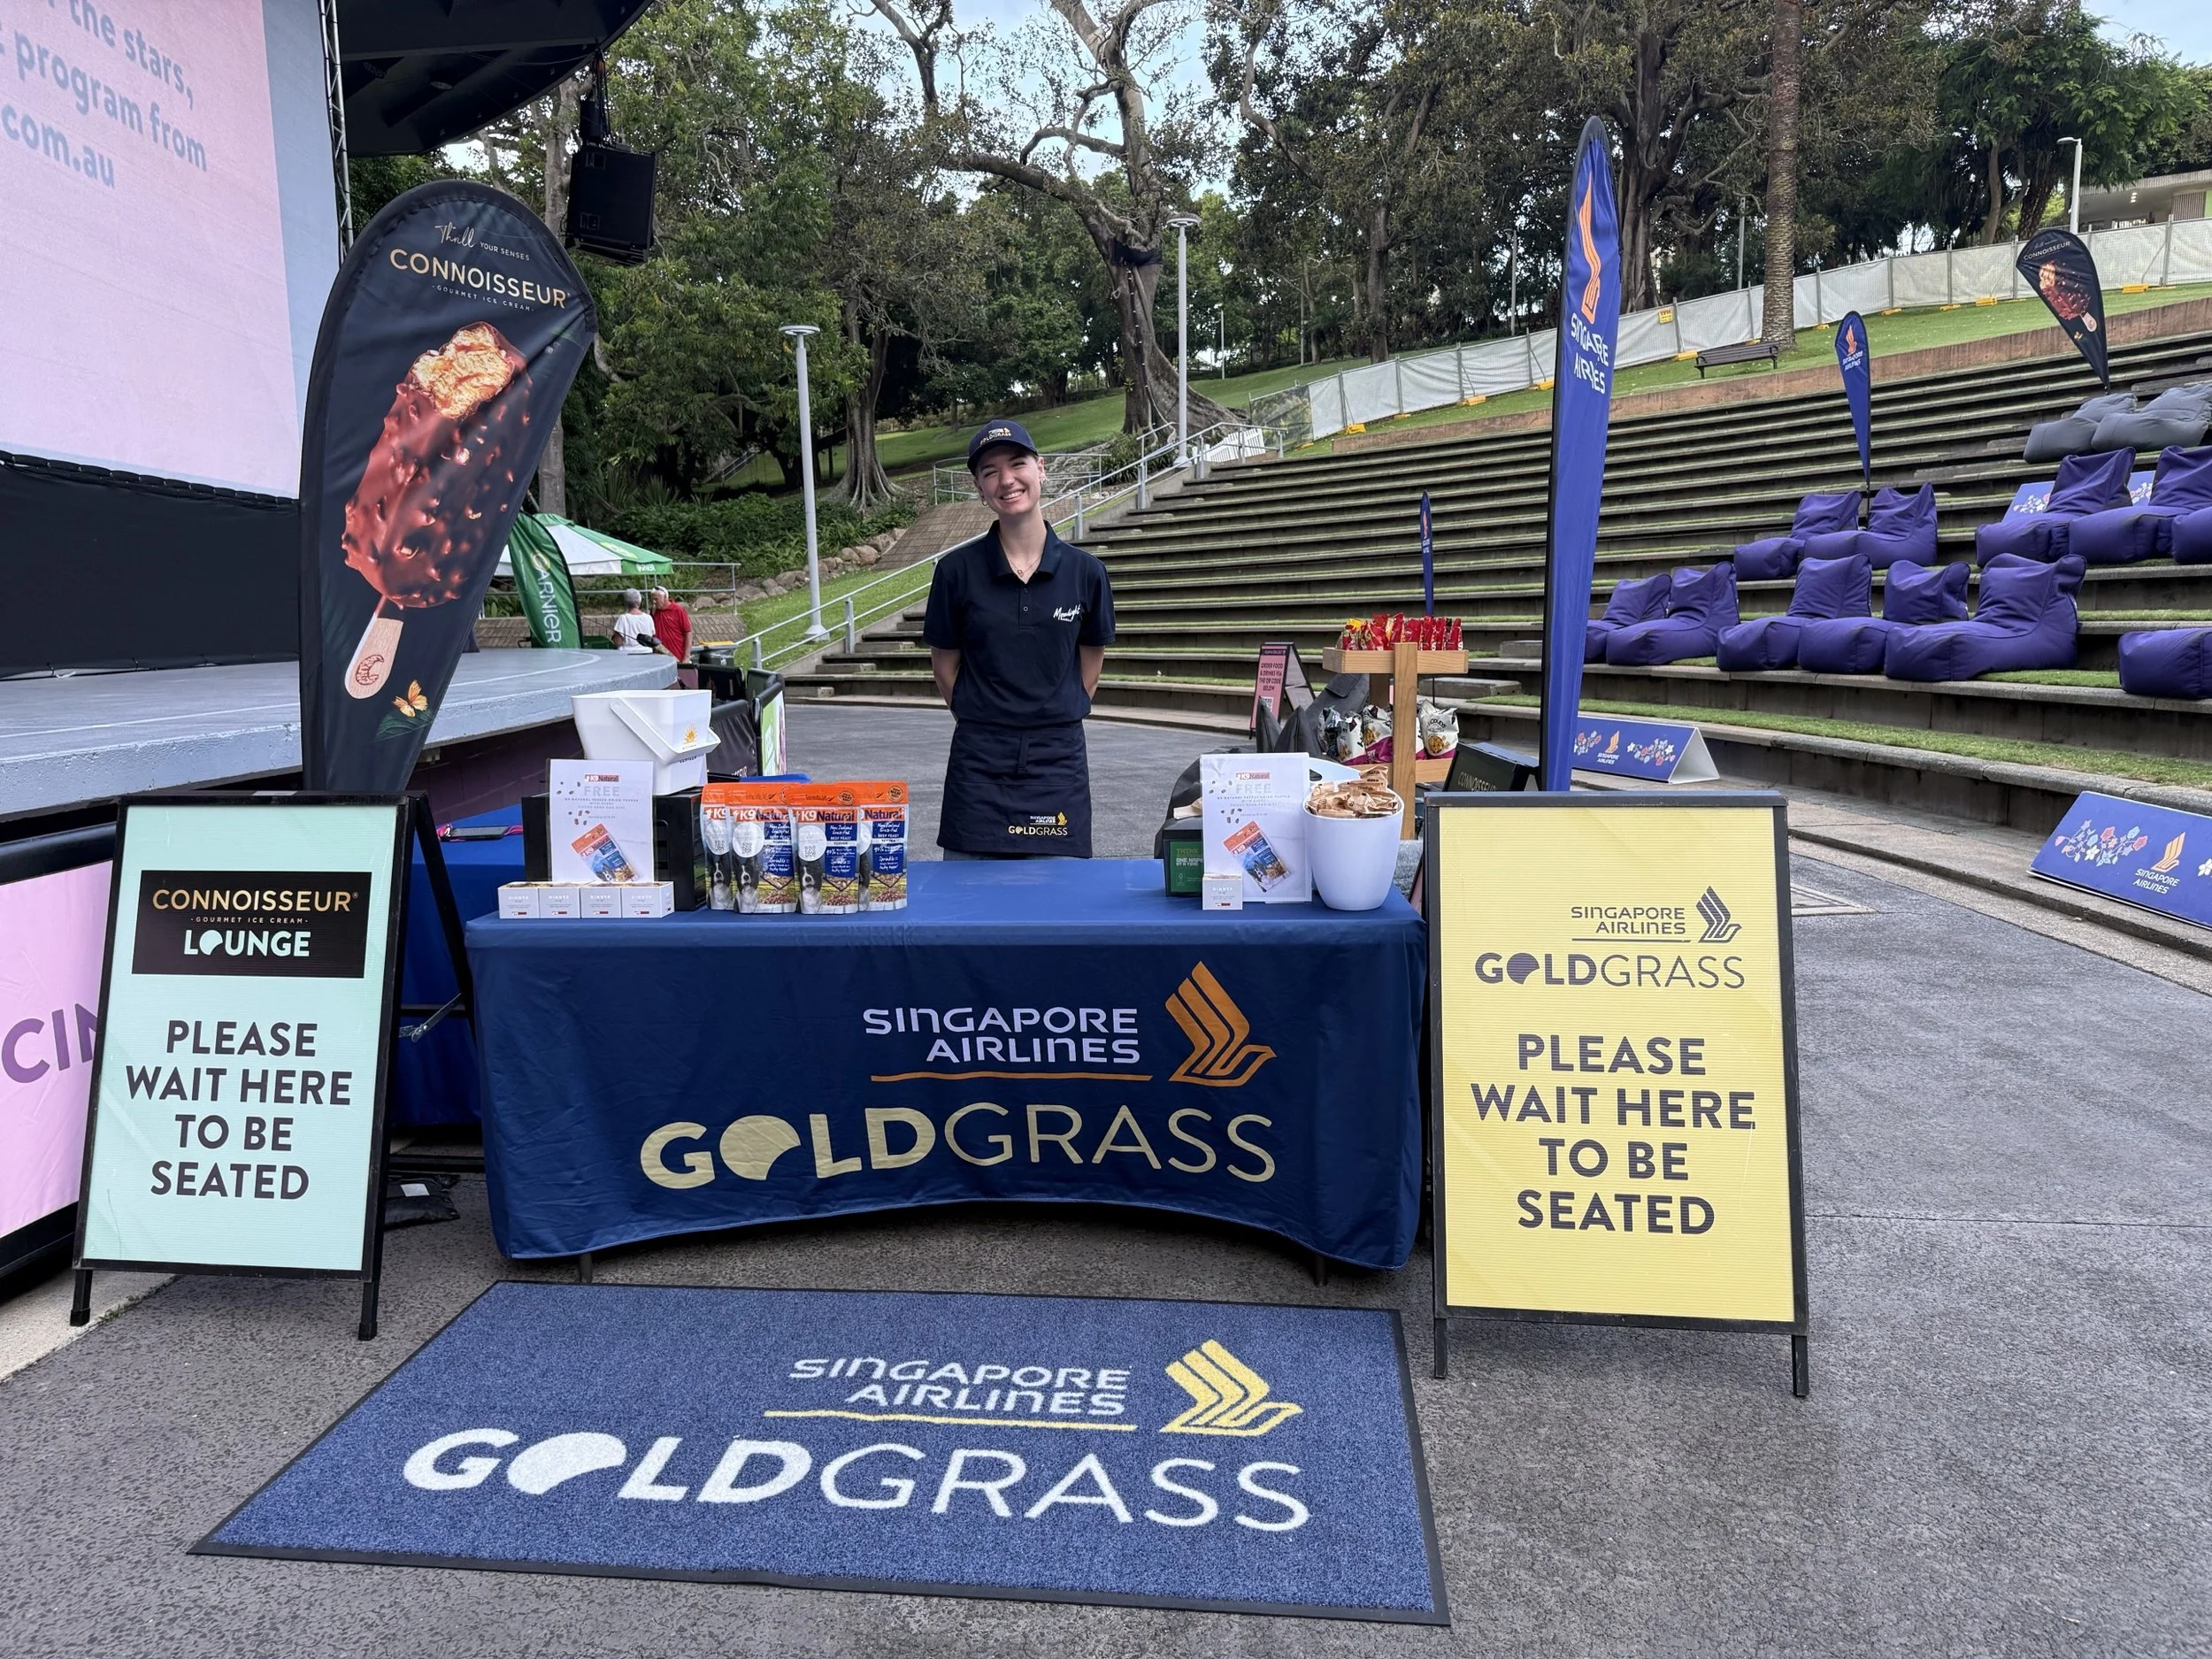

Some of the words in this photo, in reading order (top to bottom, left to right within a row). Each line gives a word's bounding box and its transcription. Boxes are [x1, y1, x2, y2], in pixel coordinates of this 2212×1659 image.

[123, 28, 194, 110] stars,
[14, 30, 143, 134] program
[149, 102, 207, 172] from
[434, 221, 475, 248] Thrill
[480, 242, 498, 253] YOUR
[501, 248, 530, 261] SENSES
[2023, 241, 2071, 261] CONNOISSEUR
[389, 249, 566, 309] CONNOISSEUR
[584, 786, 620, 796] FREE
[1235, 784, 1272, 795] FREE
[740, 808, 757, 821] K9
[801, 810, 817, 821] K9
[817, 809, 855, 822] Natural
[864, 807, 902, 821] Natural
[1008, 825, 1068, 836] GOLDGRASS
[2132, 878, 2170, 895] AIRLINES
[2135, 868, 2180, 887] SINGAPORE
[1571, 905, 1686, 920] SINGAPORE
[1595, 921, 1686, 935] AIRLINES
[183, 929, 311, 957] LOUNGE
[1474, 951, 1746, 989] GOLDGRASS
[165, 1019, 319, 1058] PLEASE
[863, 1006, 1139, 1037] SINGAPORE
[926, 1035, 1141, 1065] AIRLINES
[1517, 1033, 1707, 1076] PLEASE
[125, 1064, 227, 1102] WAIT
[240, 1068, 353, 1106] HERE
[1470, 1082, 1599, 1125] WAIT
[1617, 1087, 1756, 1130] HERE
[174, 1114, 229, 1150] TO
[243, 1116, 295, 1152] BE
[639, 1101, 1277, 1190] GOLDGRASS
[1538, 1137, 1609, 1178] TO
[1627, 1141, 1689, 1181] BE
[150, 1160, 311, 1201] SEATED
[1516, 1188, 1716, 1236] SEATED
[788, 1355, 1131, 1392] SINGAPORE
[846, 1383, 1127, 1416] AIRLINES
[402, 1426, 1311, 1532] GOLDGRASS
